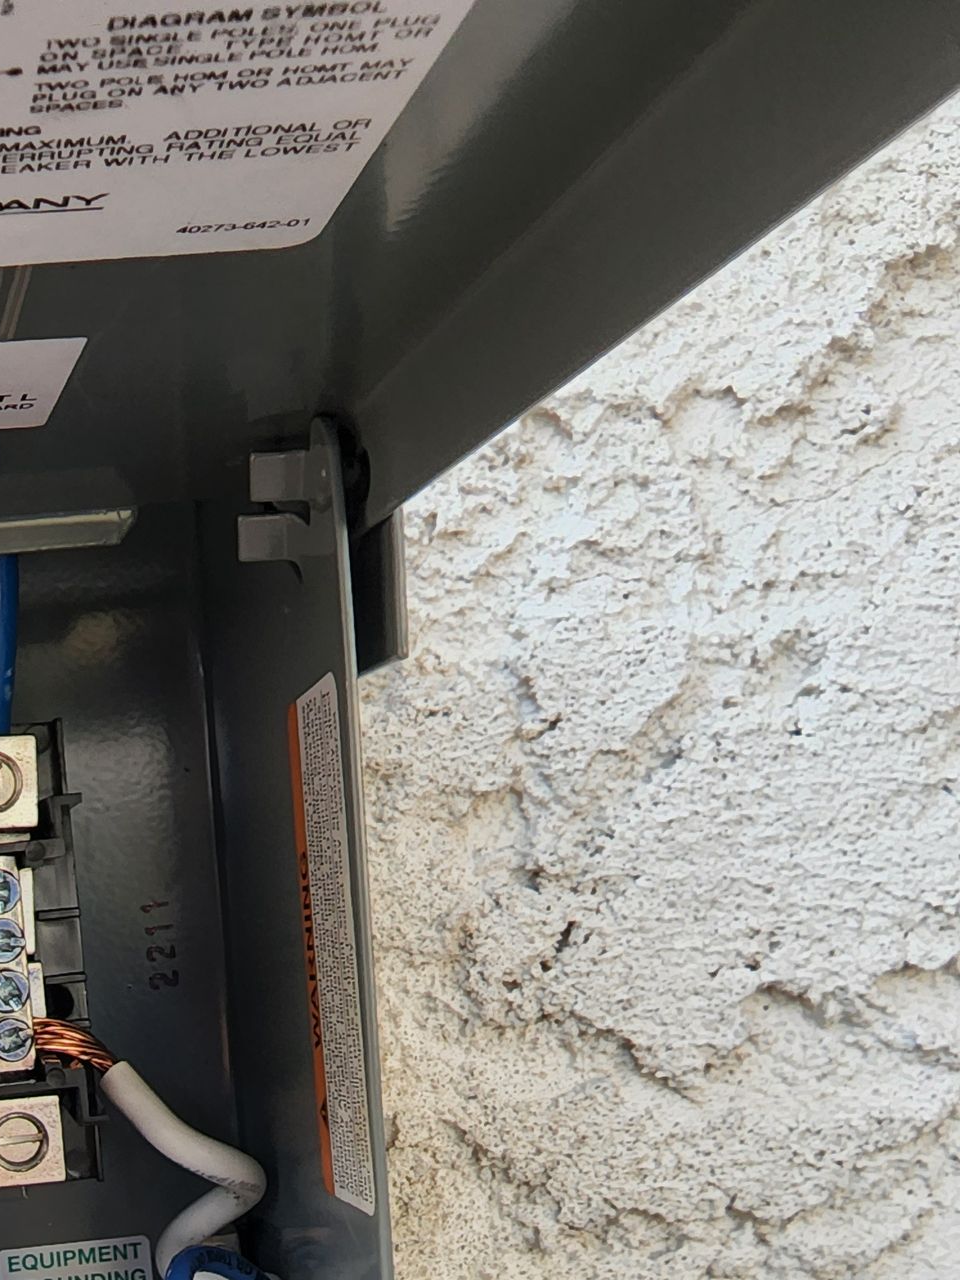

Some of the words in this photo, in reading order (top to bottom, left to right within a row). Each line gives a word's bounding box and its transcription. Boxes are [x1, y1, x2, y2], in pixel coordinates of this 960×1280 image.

[47, 37, 100, 51] TWO
[310, 21, 360, 33] ONE
[374, 14, 440, 28] PLUG
[107, 8, 252, 32] DIAGRAM
[40, 50, 78, 63] ON
[225, 36, 292, 50] TYPE
[394, 27, 434, 40] OR
[34, 79, 89, 92] TWO
[100, 73, 164, 88] POLE
[173, 70, 228, 83] HOM
[237, 67, 274, 79] OR
[282, 62, 350, 76] HOMT
[360, 58, 415, 70] MAY
[37, 62, 90, 76] MAY
[153, 51, 244, 68] SINGLE
[249, 47, 311, 60] POLE
[32, 90, 97, 104] PLUG
[107, 87, 142, 98] ON
[153, 82, 203, 96] ANY
[214, 79, 269, 92] TWO
[276, 69, 408, 87] ADJACENT
[164, 123, 321, 142] ADDITIONAL
[333, 118, 373, 130] OR
[167, 138, 263, 153] RATING
[276, 131, 361, 146] EQUAL
[105, 155, 170, 168] WITH
[185, 150, 234, 163] THE
[243, 142, 361, 160] LOWEST
[175, 218, 311, 234] 40273-642-01
[7, 1242, 143, 1273] EQUIPMENT
